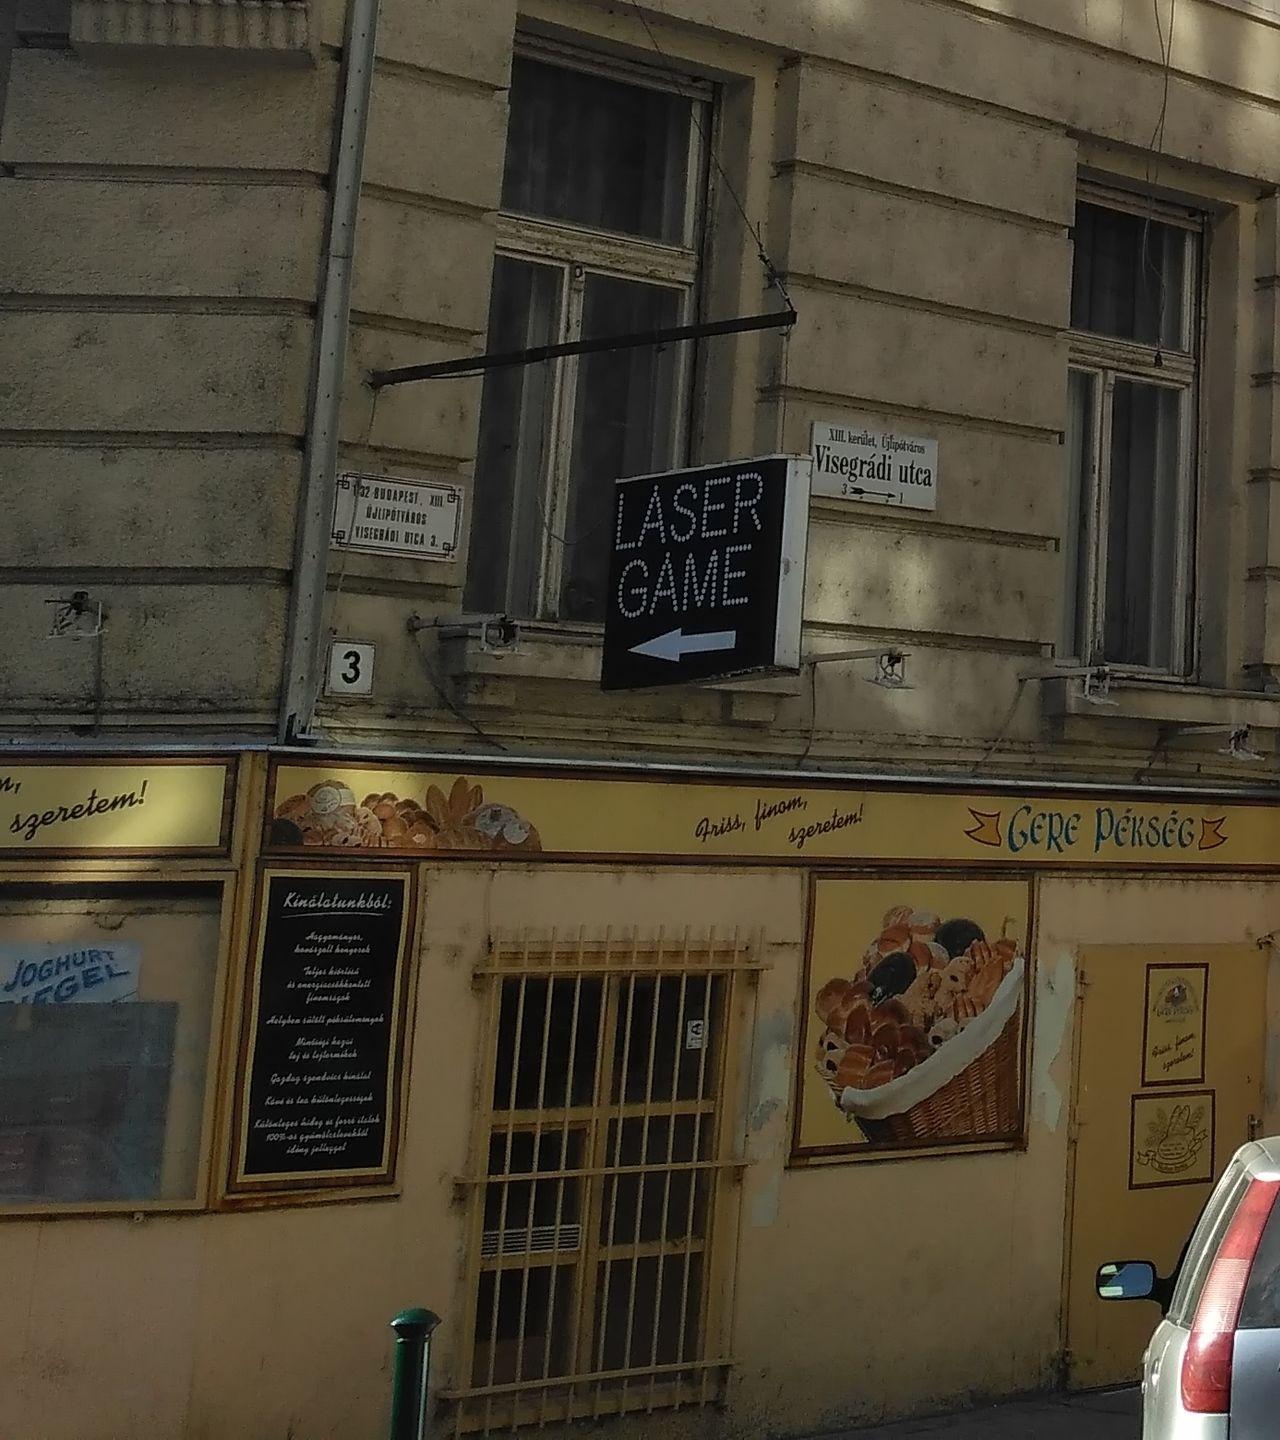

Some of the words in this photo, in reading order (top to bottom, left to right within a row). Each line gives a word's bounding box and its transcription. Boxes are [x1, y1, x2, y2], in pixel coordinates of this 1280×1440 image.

[829, 428, 846, 442] XIII.
[848, 430, 877, 448] kerület,
[882, 434, 925, 454] Újlipótváros
[815, 444, 892, 482] Visegrádi
[899, 460, 932, 487] utca
[353, 485, 369, 498] 132
[842, 483, 847, 495] 3
[616, 473, 763, 550] LASER
[355, 526, 399, 543] VISEGRÁDI
[405, 532, 424, 545] UTCA
[618, 543, 752, 619] GAME
[341, 650, 360, 683] 3
[10, 780, 148, 841] szeretem!
[695, 814, 745, 842] Friss,
[755, 796, 807, 831] finom,
[788, 803, 863, 849] szeretem!
[1008, 805, 1081, 852] GERE
[283, 892, 392, 909] Kínálatunkból:
[5, 950, 114, 992] JOGHURT
[18, 965, 129, 1005] EGEL
